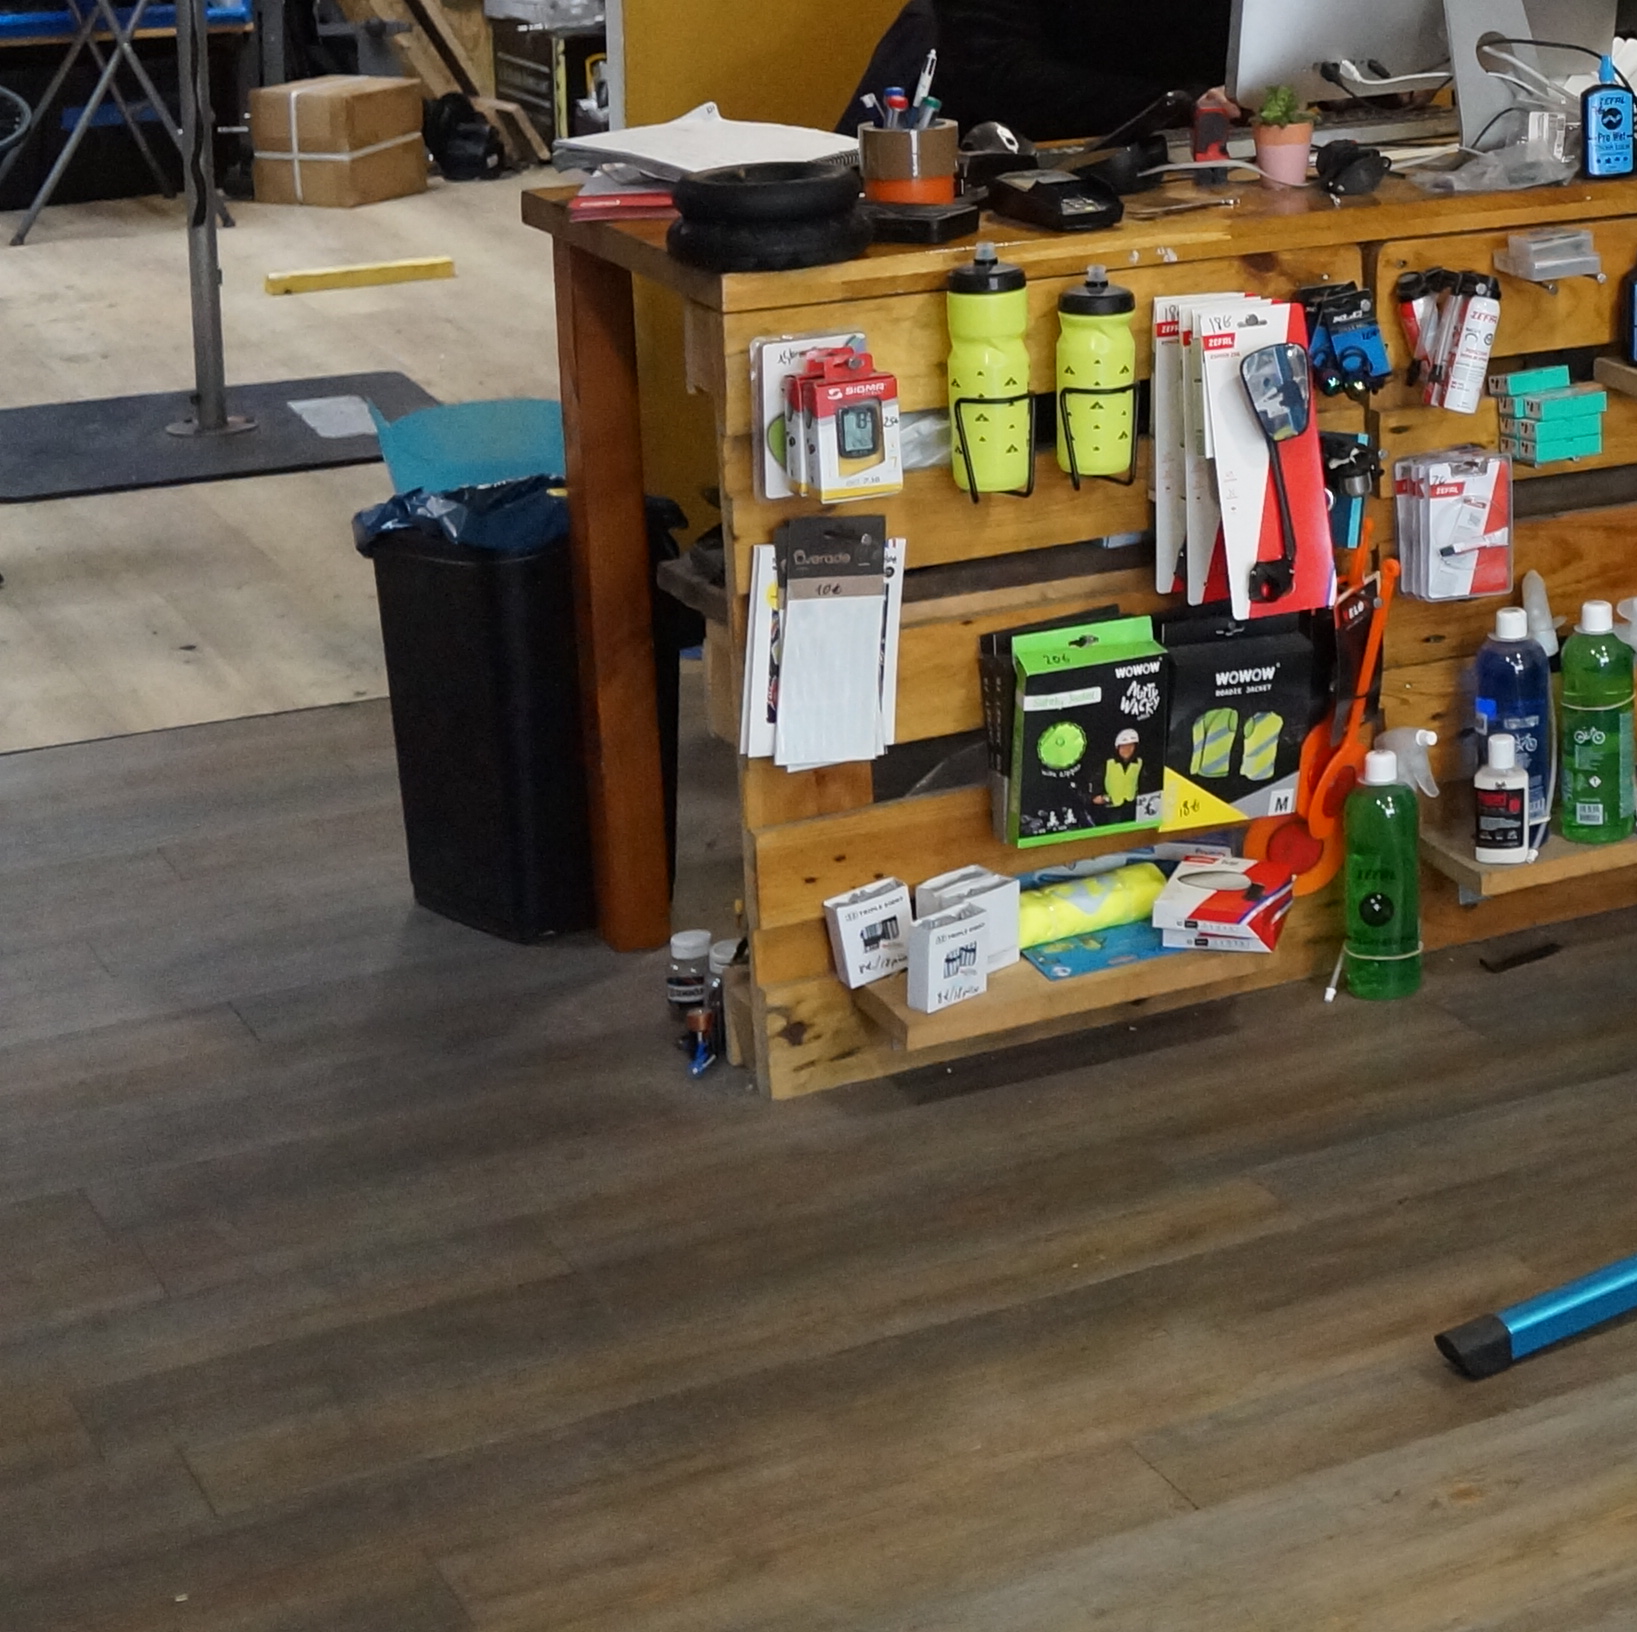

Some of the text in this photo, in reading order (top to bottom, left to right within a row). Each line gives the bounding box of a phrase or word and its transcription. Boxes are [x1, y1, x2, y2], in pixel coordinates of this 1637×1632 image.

[1208, 337, 1233, 348] ZEFAL
[845, 382, 885, 397] SIGMA
[1436, 486, 1459, 495] ZEFAL
[1115, 660, 1161, 679] WOWOW
[1215, 666, 1276, 687] WOWOW
[1246, 683, 1273, 694] JACKET
[1275, 797, 1288, 812] M
